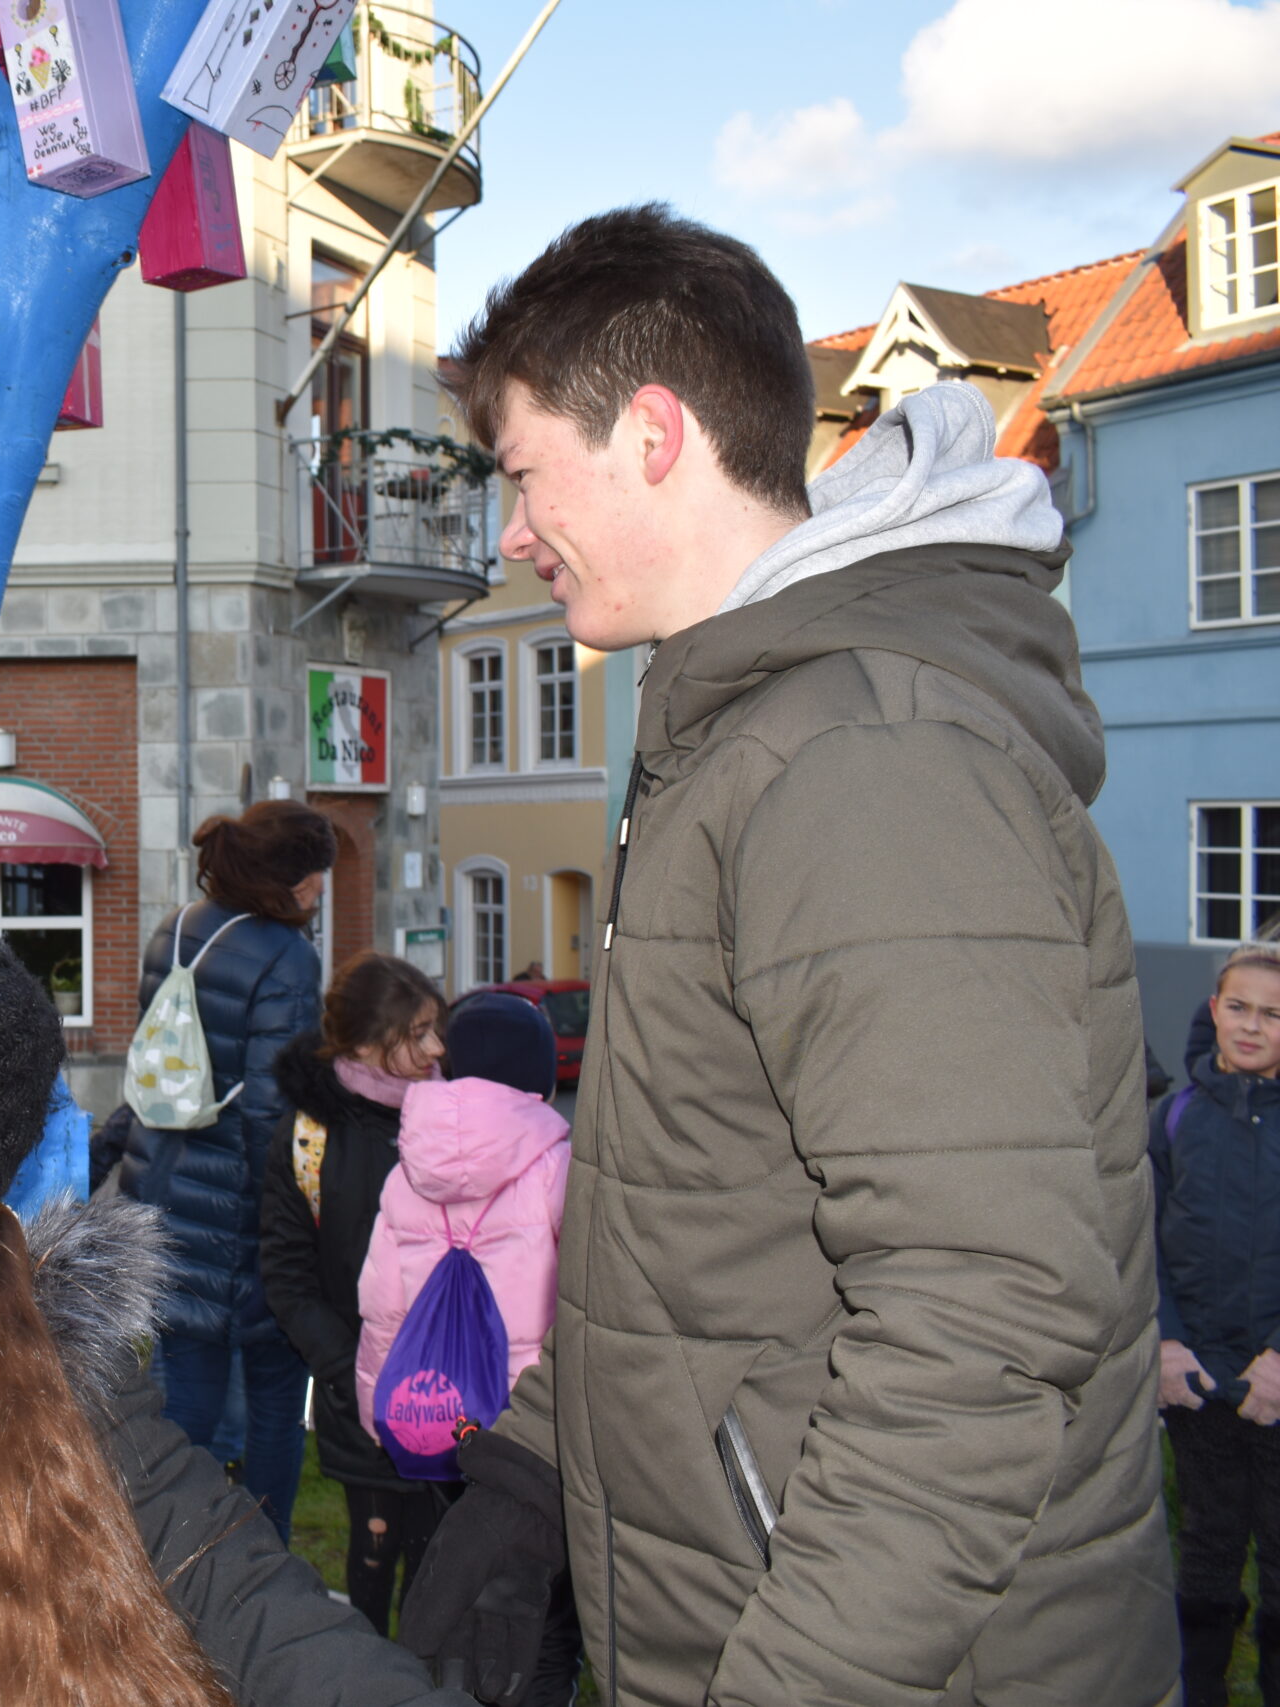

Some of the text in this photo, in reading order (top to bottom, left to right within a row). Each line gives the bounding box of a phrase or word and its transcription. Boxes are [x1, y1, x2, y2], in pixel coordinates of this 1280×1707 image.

[34, 134, 76, 159] Denmark
[312, 690, 383, 735] Restaurant
[318, 738, 376, 763] Da Nico
